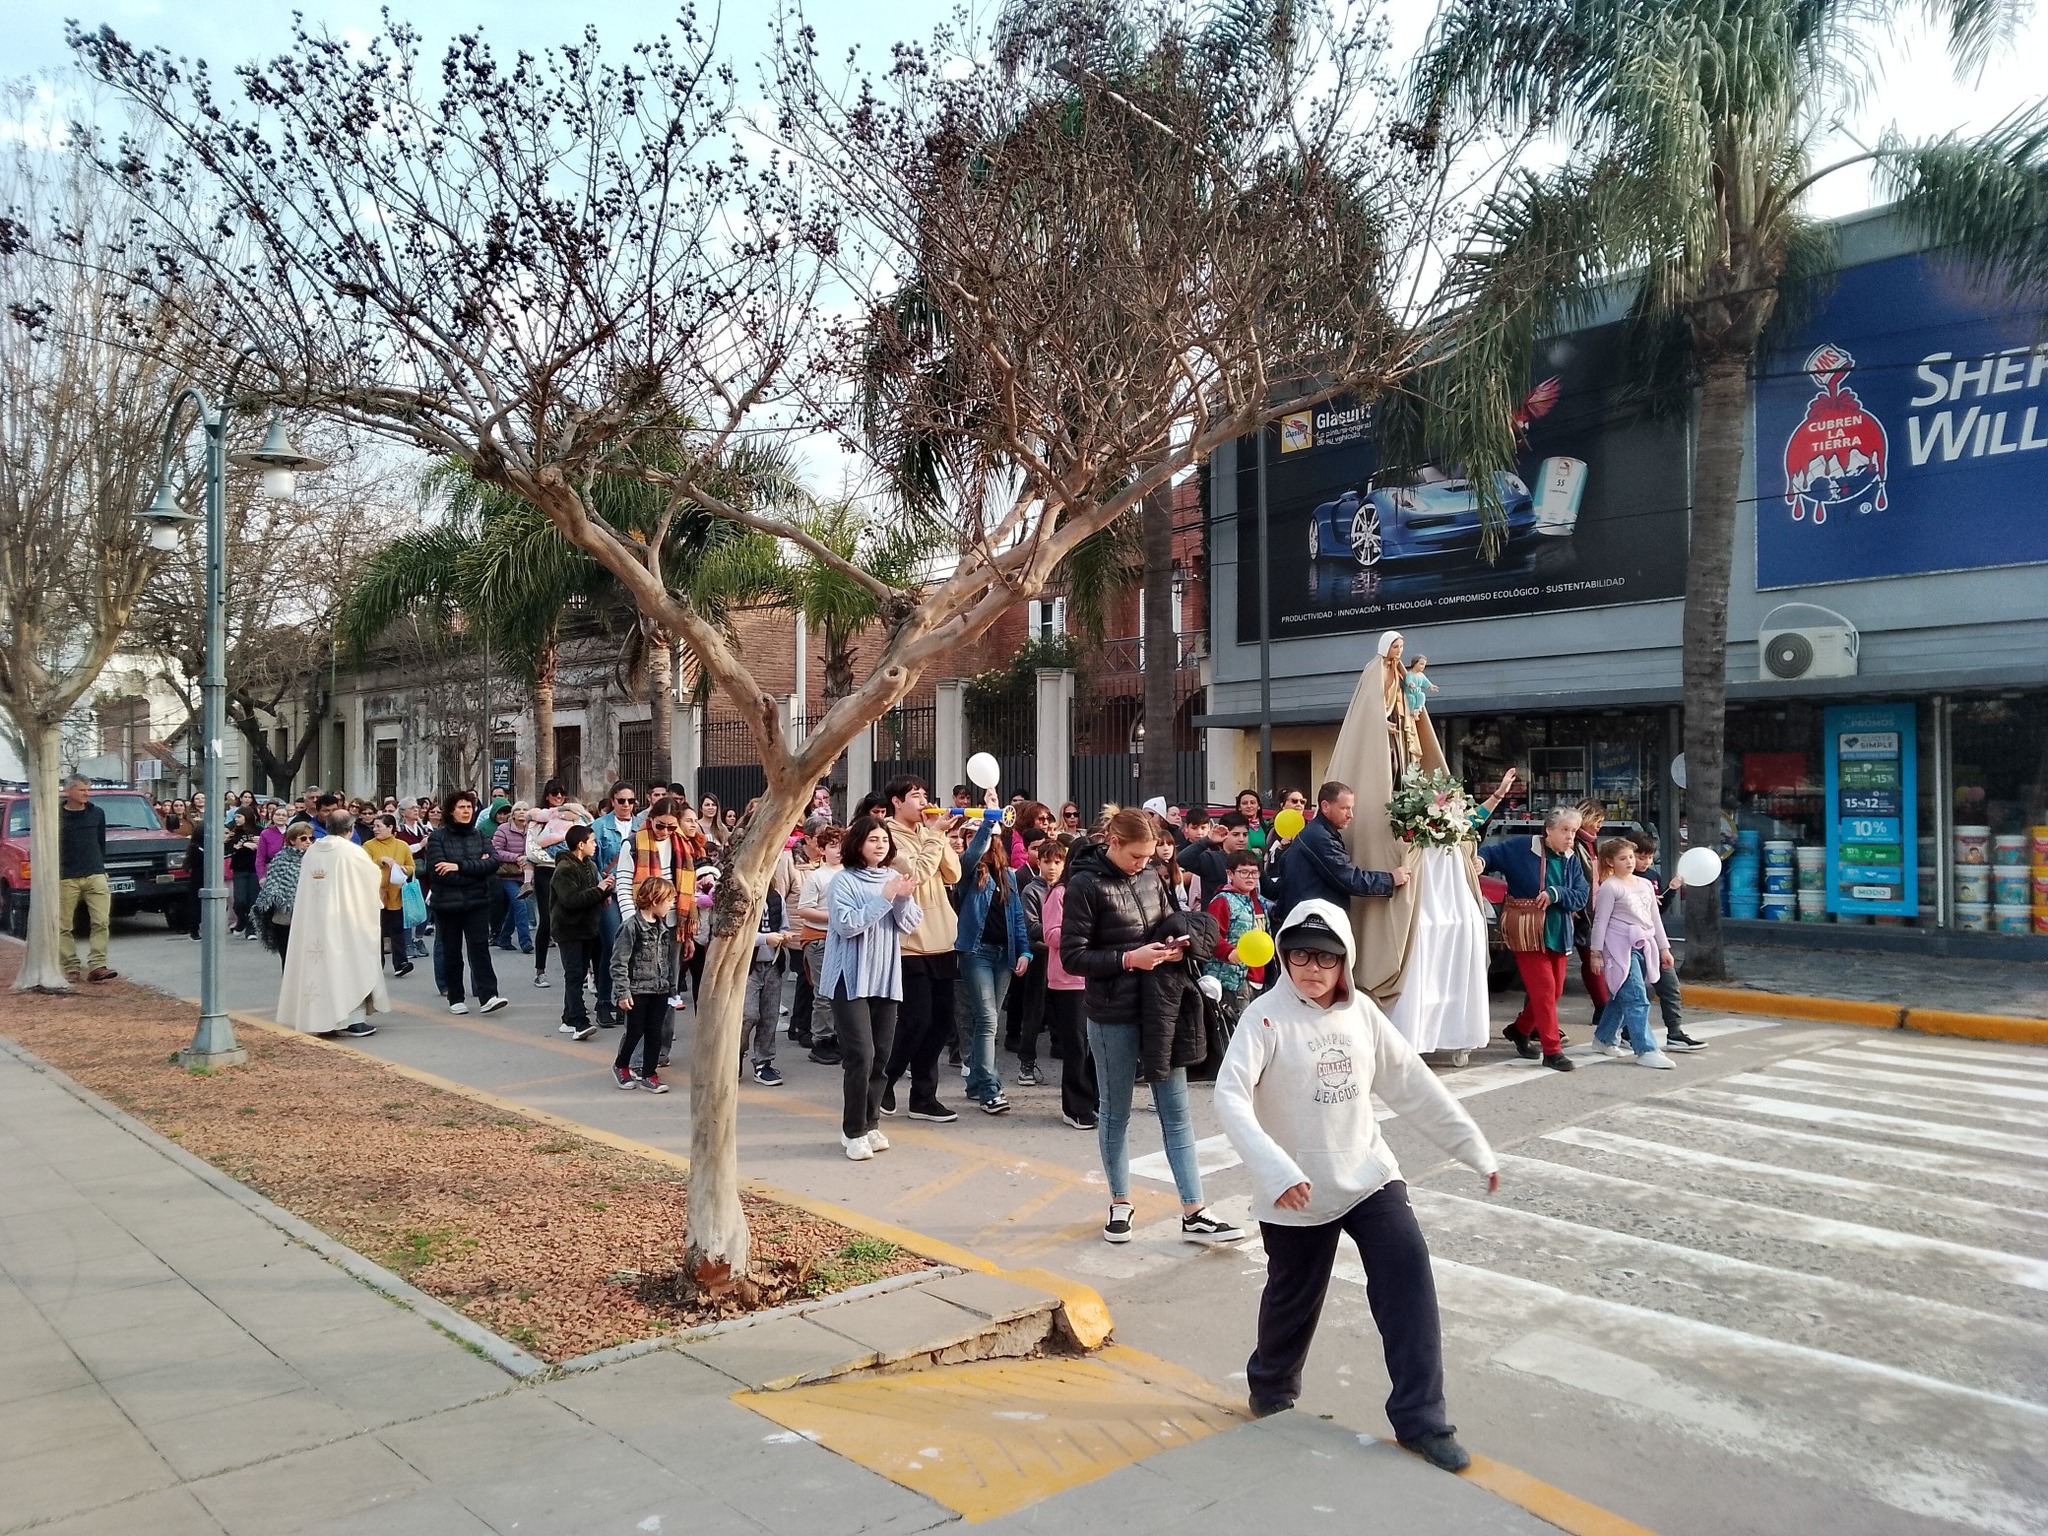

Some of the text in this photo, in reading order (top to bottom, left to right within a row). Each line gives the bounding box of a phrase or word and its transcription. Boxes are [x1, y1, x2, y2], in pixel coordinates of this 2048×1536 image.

[1808, 415, 1863, 432] CUBREN
[1827, 429, 1846, 440] LA
[1908, 405, 2048, 466] WILL
[1811, 435, 1862, 452] TIERRA
[1281, 577, 1626, 624] PRODUCTIVIDAD INNOVACIÓN TECNOLOGÍA COMPROMISO ECOLÓGICO SUSTENTABILIDAD
[1860, 741, 1894, 749] SIMPLE
[1852, 821, 1887, 836] 10%
[1308, 1033, 1352, 1052] CAMPUS
[1318, 1059, 1352, 1077] COLLEGE
[1314, 1084, 1360, 1104] LEAGUE
